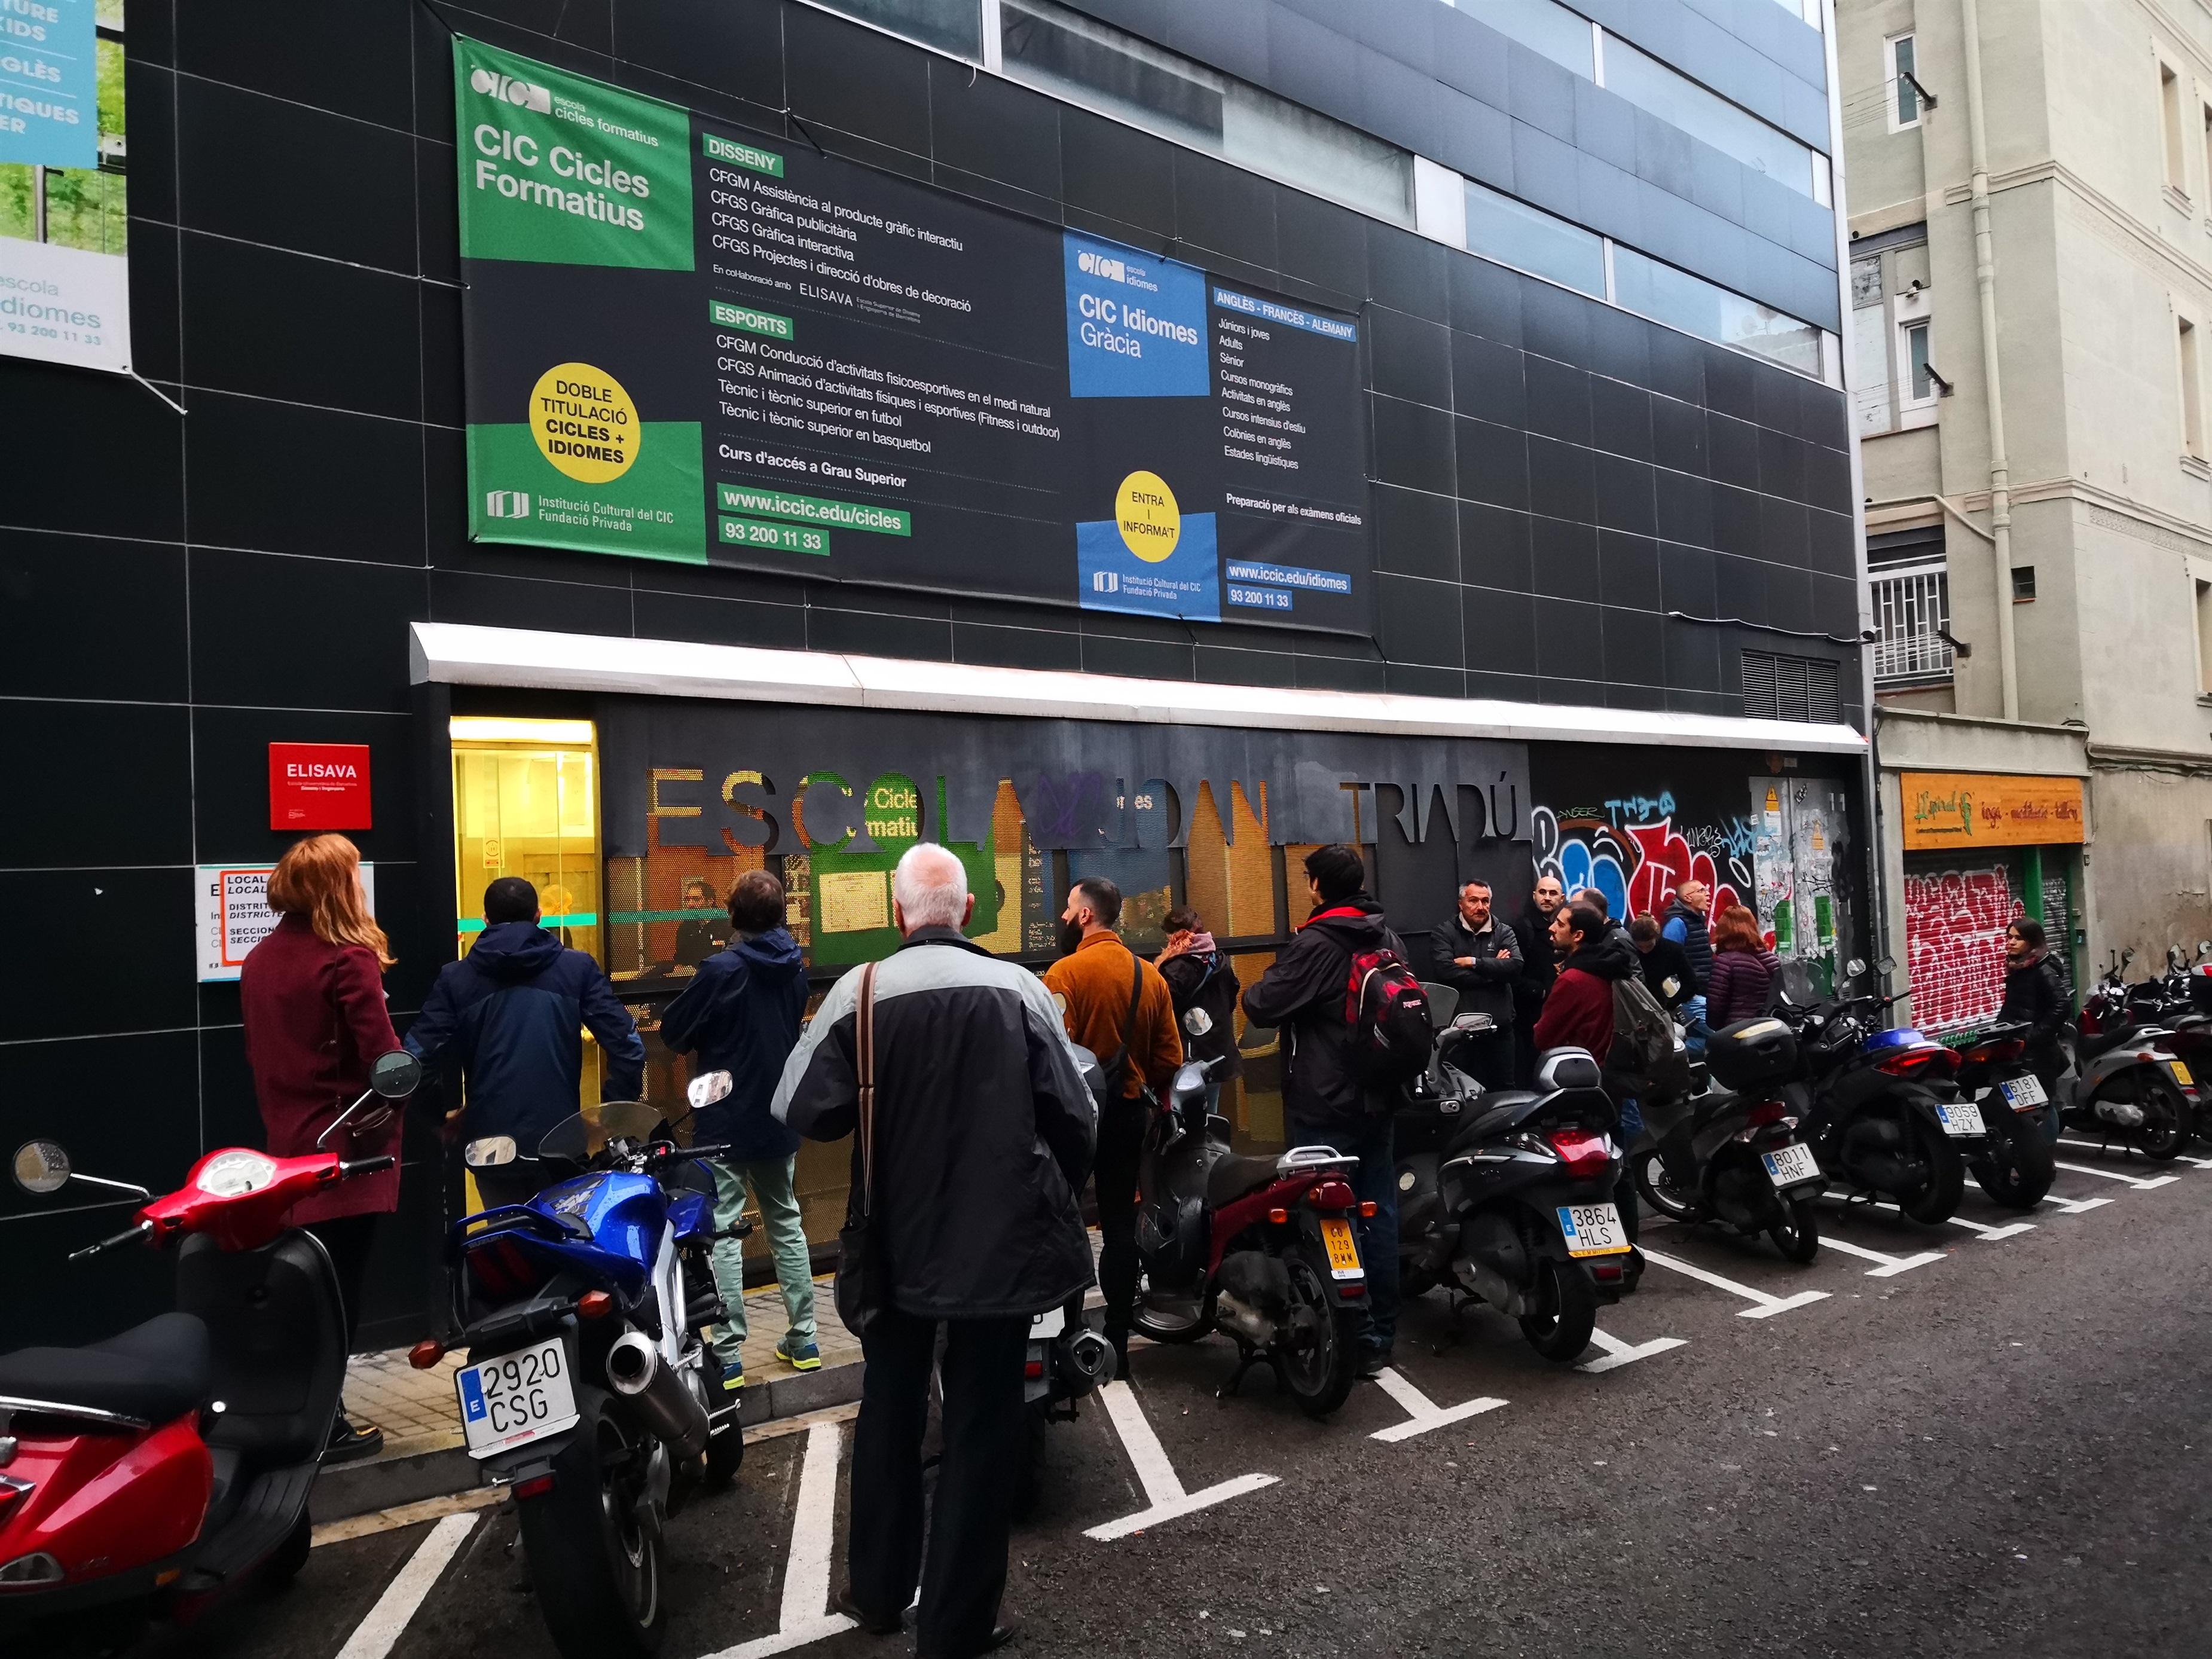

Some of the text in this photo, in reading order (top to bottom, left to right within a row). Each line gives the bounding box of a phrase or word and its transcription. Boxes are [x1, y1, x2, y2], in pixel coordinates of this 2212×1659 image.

[554, 96, 586, 112] escola
[555, 106, 659, 147] cicles formatius
[474, 123, 650, 198] CIC Cicles
[708, 139, 776, 171] DISSENY
[476, 158, 644, 231] Formatius
[709, 167, 963, 252] CFGM Assistència al producte gràfic interactiu
[710, 190, 858, 243] CFGS Gràfica publicitària
[711, 212, 855, 262] CFGS Gràfica interactiva
[712, 234, 750, 255] CFGS
[753, 243, 808, 270] Projectes
[810, 258, 814, 271] i
[816, 261, 860, 283] direcció
[863, 274, 903, 295] d'obres
[905, 285, 919, 299] de
[921, 289, 971, 312] decoració
[713, 264, 724, 274] En
[774, 280, 792, 291] amb
[799, 282, 853, 307] ELISAVA
[1126, 274, 1159, 292] idiomes
[715, 305, 787, 335] ESPORTS
[1079, 293, 1198, 346] CIC Idiomes
[1218, 317, 1270, 341] Júniors i joves
[1312, 319, 1353, 339] ALEMANY
[8, 322, 101, 346] 93 200 11 33
[1080, 321, 1142, 359] Gràcia
[1218, 335, 1244, 350] Adults
[1220, 352, 1245, 368] Sènior
[716, 334, 757, 355] CFGM
[760, 344, 824, 369] Conducció
[886, 371, 966, 401] fisicoesportives
[967, 392, 980, 403] en
[982, 393, 991, 406] el
[994, 398, 1018, 411] medi
[1019, 403, 1051, 418] natural
[1220, 369, 1293, 396] Cursos monogràfics
[556, 380, 613, 404] DOBLE
[717, 356, 755, 376] CFGS
[757, 365, 812, 388] Animació
[875, 390, 916, 410] físiques
[918, 398, 922, 411] i
[924, 402, 976, 421] esportives
[977, 411, 1015, 430] (Fitness
[1016, 418, 1020, 431] i
[1021, 423, 1061, 441] outdoor)
[717, 378, 902, 427] Tècnic i tècnic superior en futbol
[1221, 387, 1291, 413] Activitats en anglès
[540, 397, 628, 425] TITULACIÓ
[1222, 406, 1250, 422] Cursos
[1250, 412, 1282, 429] intensius
[546, 418, 610, 442] CICLES
[719, 401, 931, 453] Tècnic i tècnic superior en basquetbol
[1223, 426, 1292, 450] Colònies en anglès
[548, 439, 625, 464] IDIOMES
[1224, 445, 1255, 461] Estades
[719, 444, 753, 462] Curs
[809, 463, 818, 473] a
[821, 462, 853, 479] Grau
[854, 467, 907, 488] Superior
[539, 494, 674, 524] Institució Cultural del CIC
[724, 491, 902, 530] www.iccic.edu/cicles
[1132, 491, 1165, 508] ENTRA
[1226, 493, 1362, 525] Preparació per als exàmens oficials
[539, 509, 633, 533] Fundació Privada
[1123, 520, 1175, 539] INFORMA'T
[725, 523, 822, 550] 93 200 11 33
[1229, 564, 1348, 592] www.iccic.edu/idiomes
[1230, 589, 1290, 607] 93 200 11 33
[287, 763, 358, 778] ELISAVA
[1339, 771, 1519, 844] TRIADÚ
[227, 875, 267, 884] LOCAL
[2008, 1077, 2037, 1093] 6181
[2015, 1090, 2037, 1106] DFF
[1945, 1105, 1978, 1119] 9059
[1950, 1118, 1976, 1132] HZX
[1774, 1146, 1808, 1166] 8011
[1780, 1162, 1805, 1181] HNF
[1572, 1206, 1617, 1227] 3864
[1578, 1227, 1612, 1246] HLS
[483, 1348, 561, 1400] 2920
[469, 1400, 481, 1413] E
[490, 1388, 549, 1433] CSG
